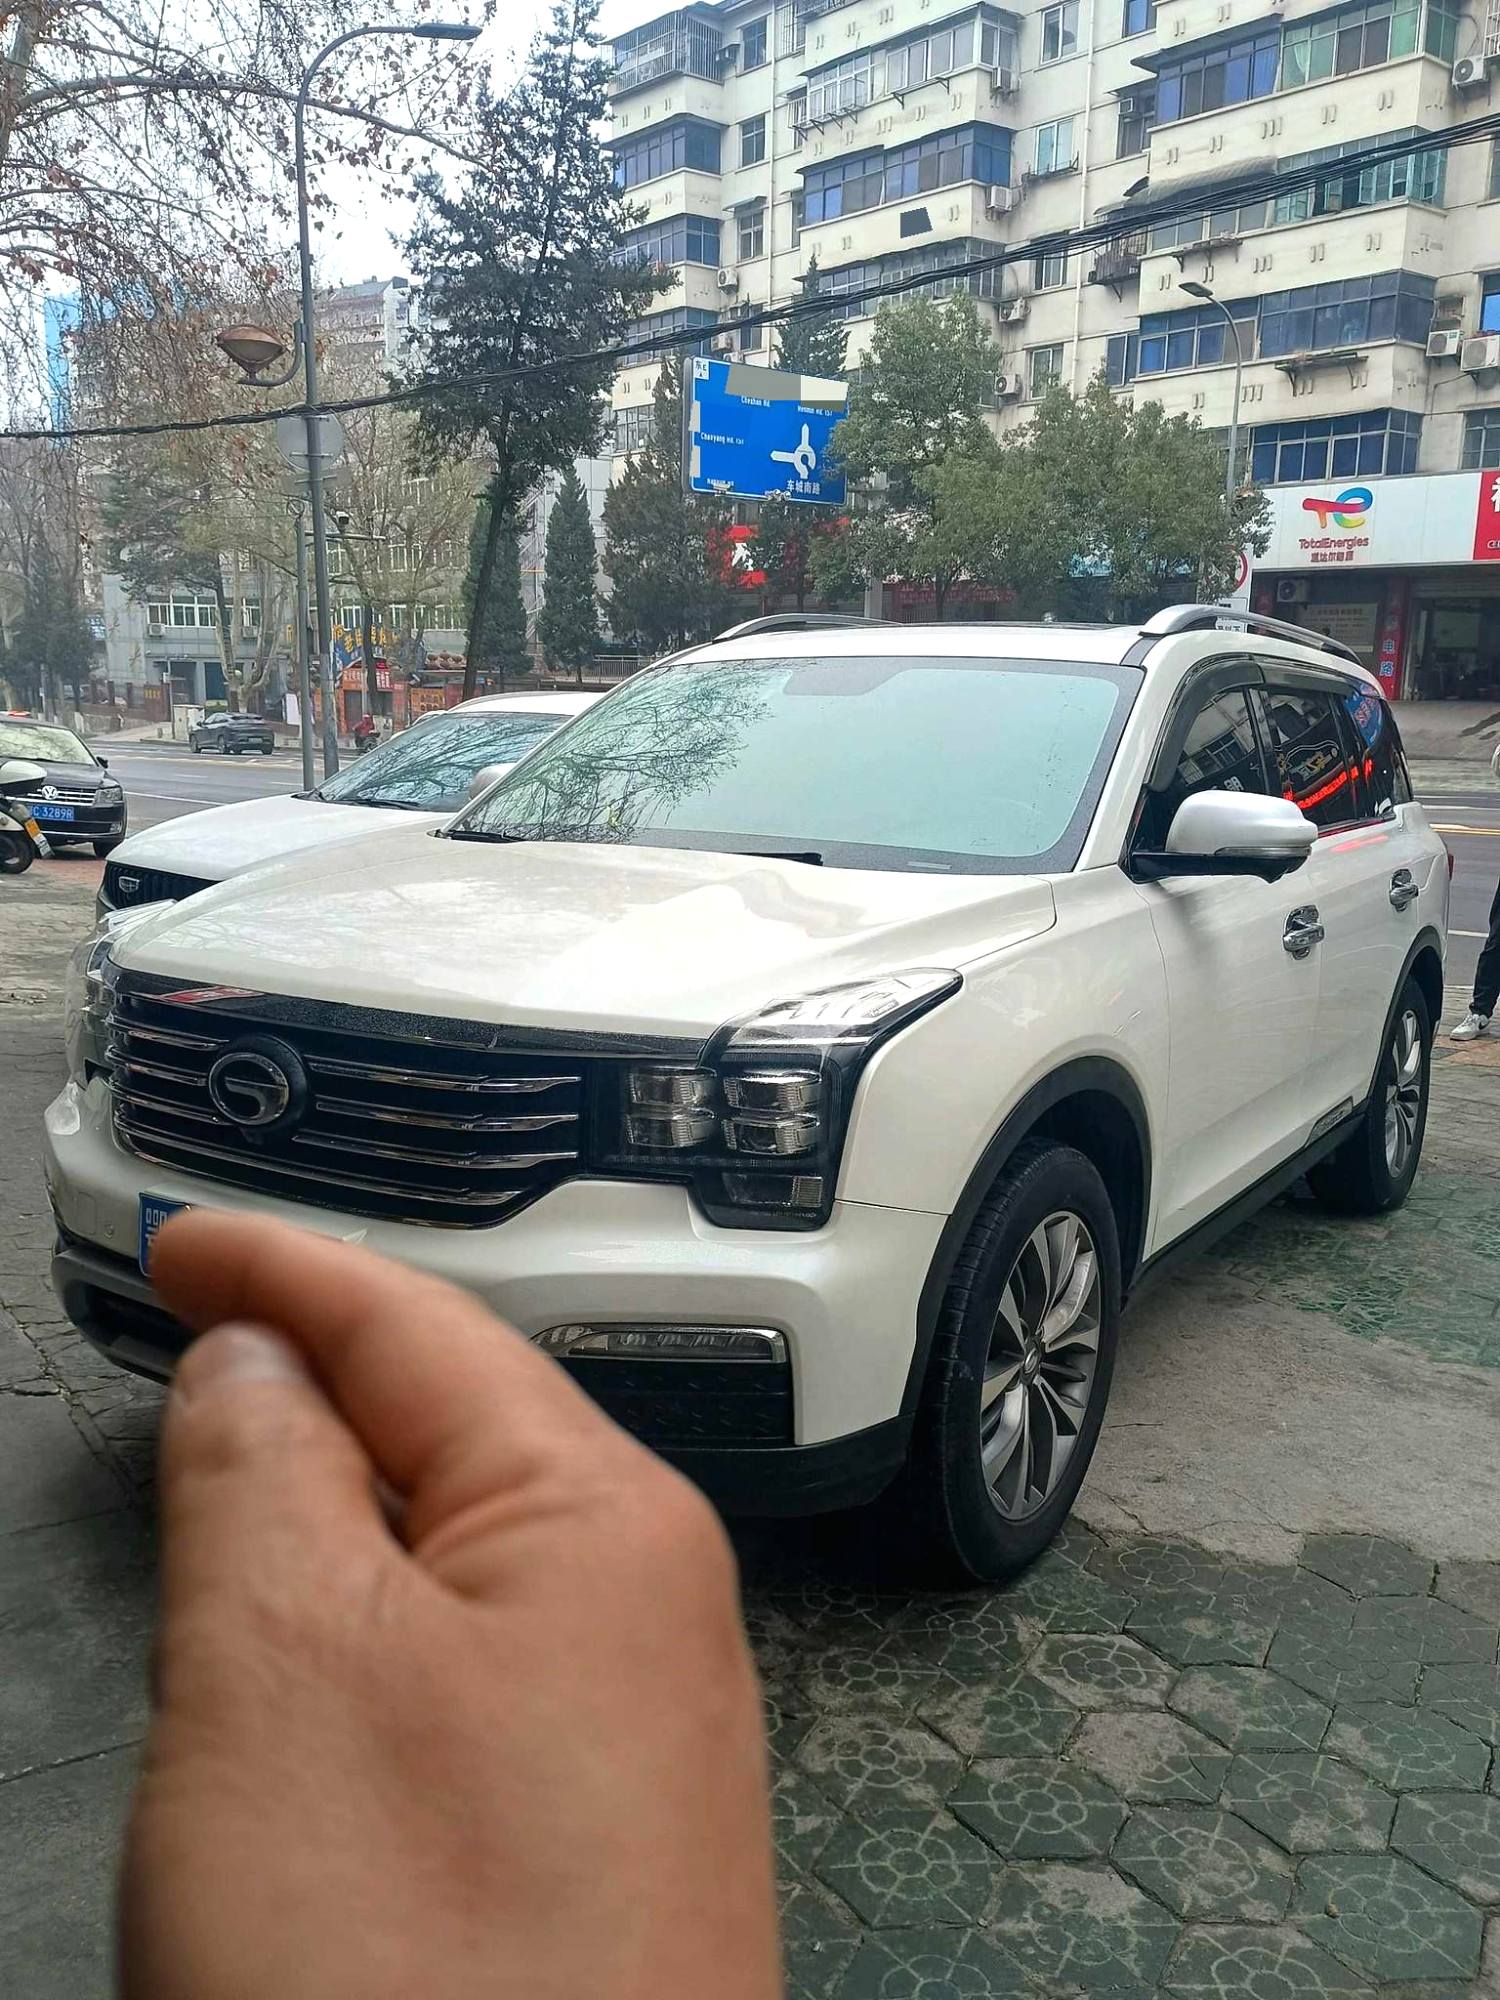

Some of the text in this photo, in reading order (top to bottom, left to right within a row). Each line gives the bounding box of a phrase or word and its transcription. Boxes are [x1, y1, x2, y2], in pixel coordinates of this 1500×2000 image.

[787, 478, 820, 495] 车城南路
[1299, 536, 1369, 550] TotalEnergies
